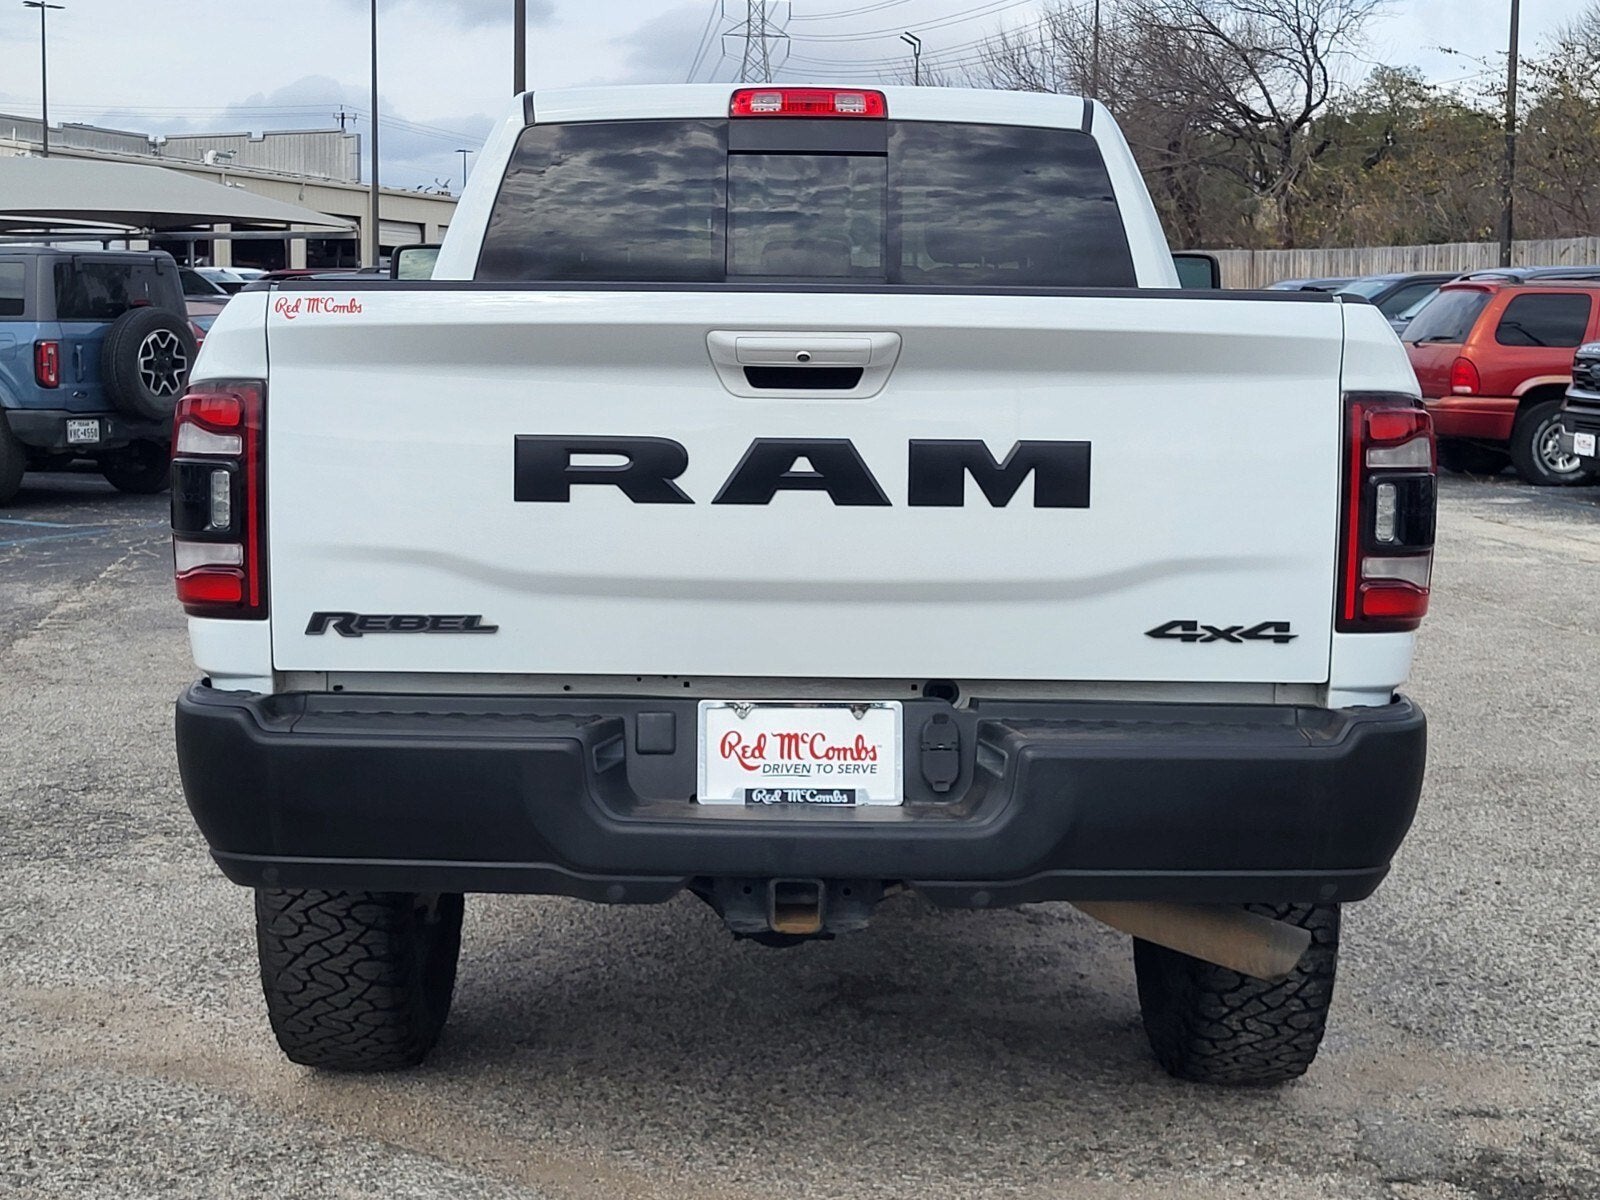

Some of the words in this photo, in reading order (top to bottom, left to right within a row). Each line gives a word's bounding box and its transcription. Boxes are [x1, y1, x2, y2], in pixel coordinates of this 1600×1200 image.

[275, 297, 302, 319] Red
[304, 297, 362, 313] McCombs
[513, 434, 1092, 509] RAM
[304, 611, 500, 637] REBEL
[1144, 620, 1299, 643] 4x4
[720, 730, 767, 771] Red
[771, 732, 878, 761] McCombs
[762, 763, 811, 774] DRIVEN
[816, 763, 834, 774] TO
[837, 763, 878, 774] SERVE
[752, 789, 782, 805] Red
[784, 789, 848, 803] McCombs
